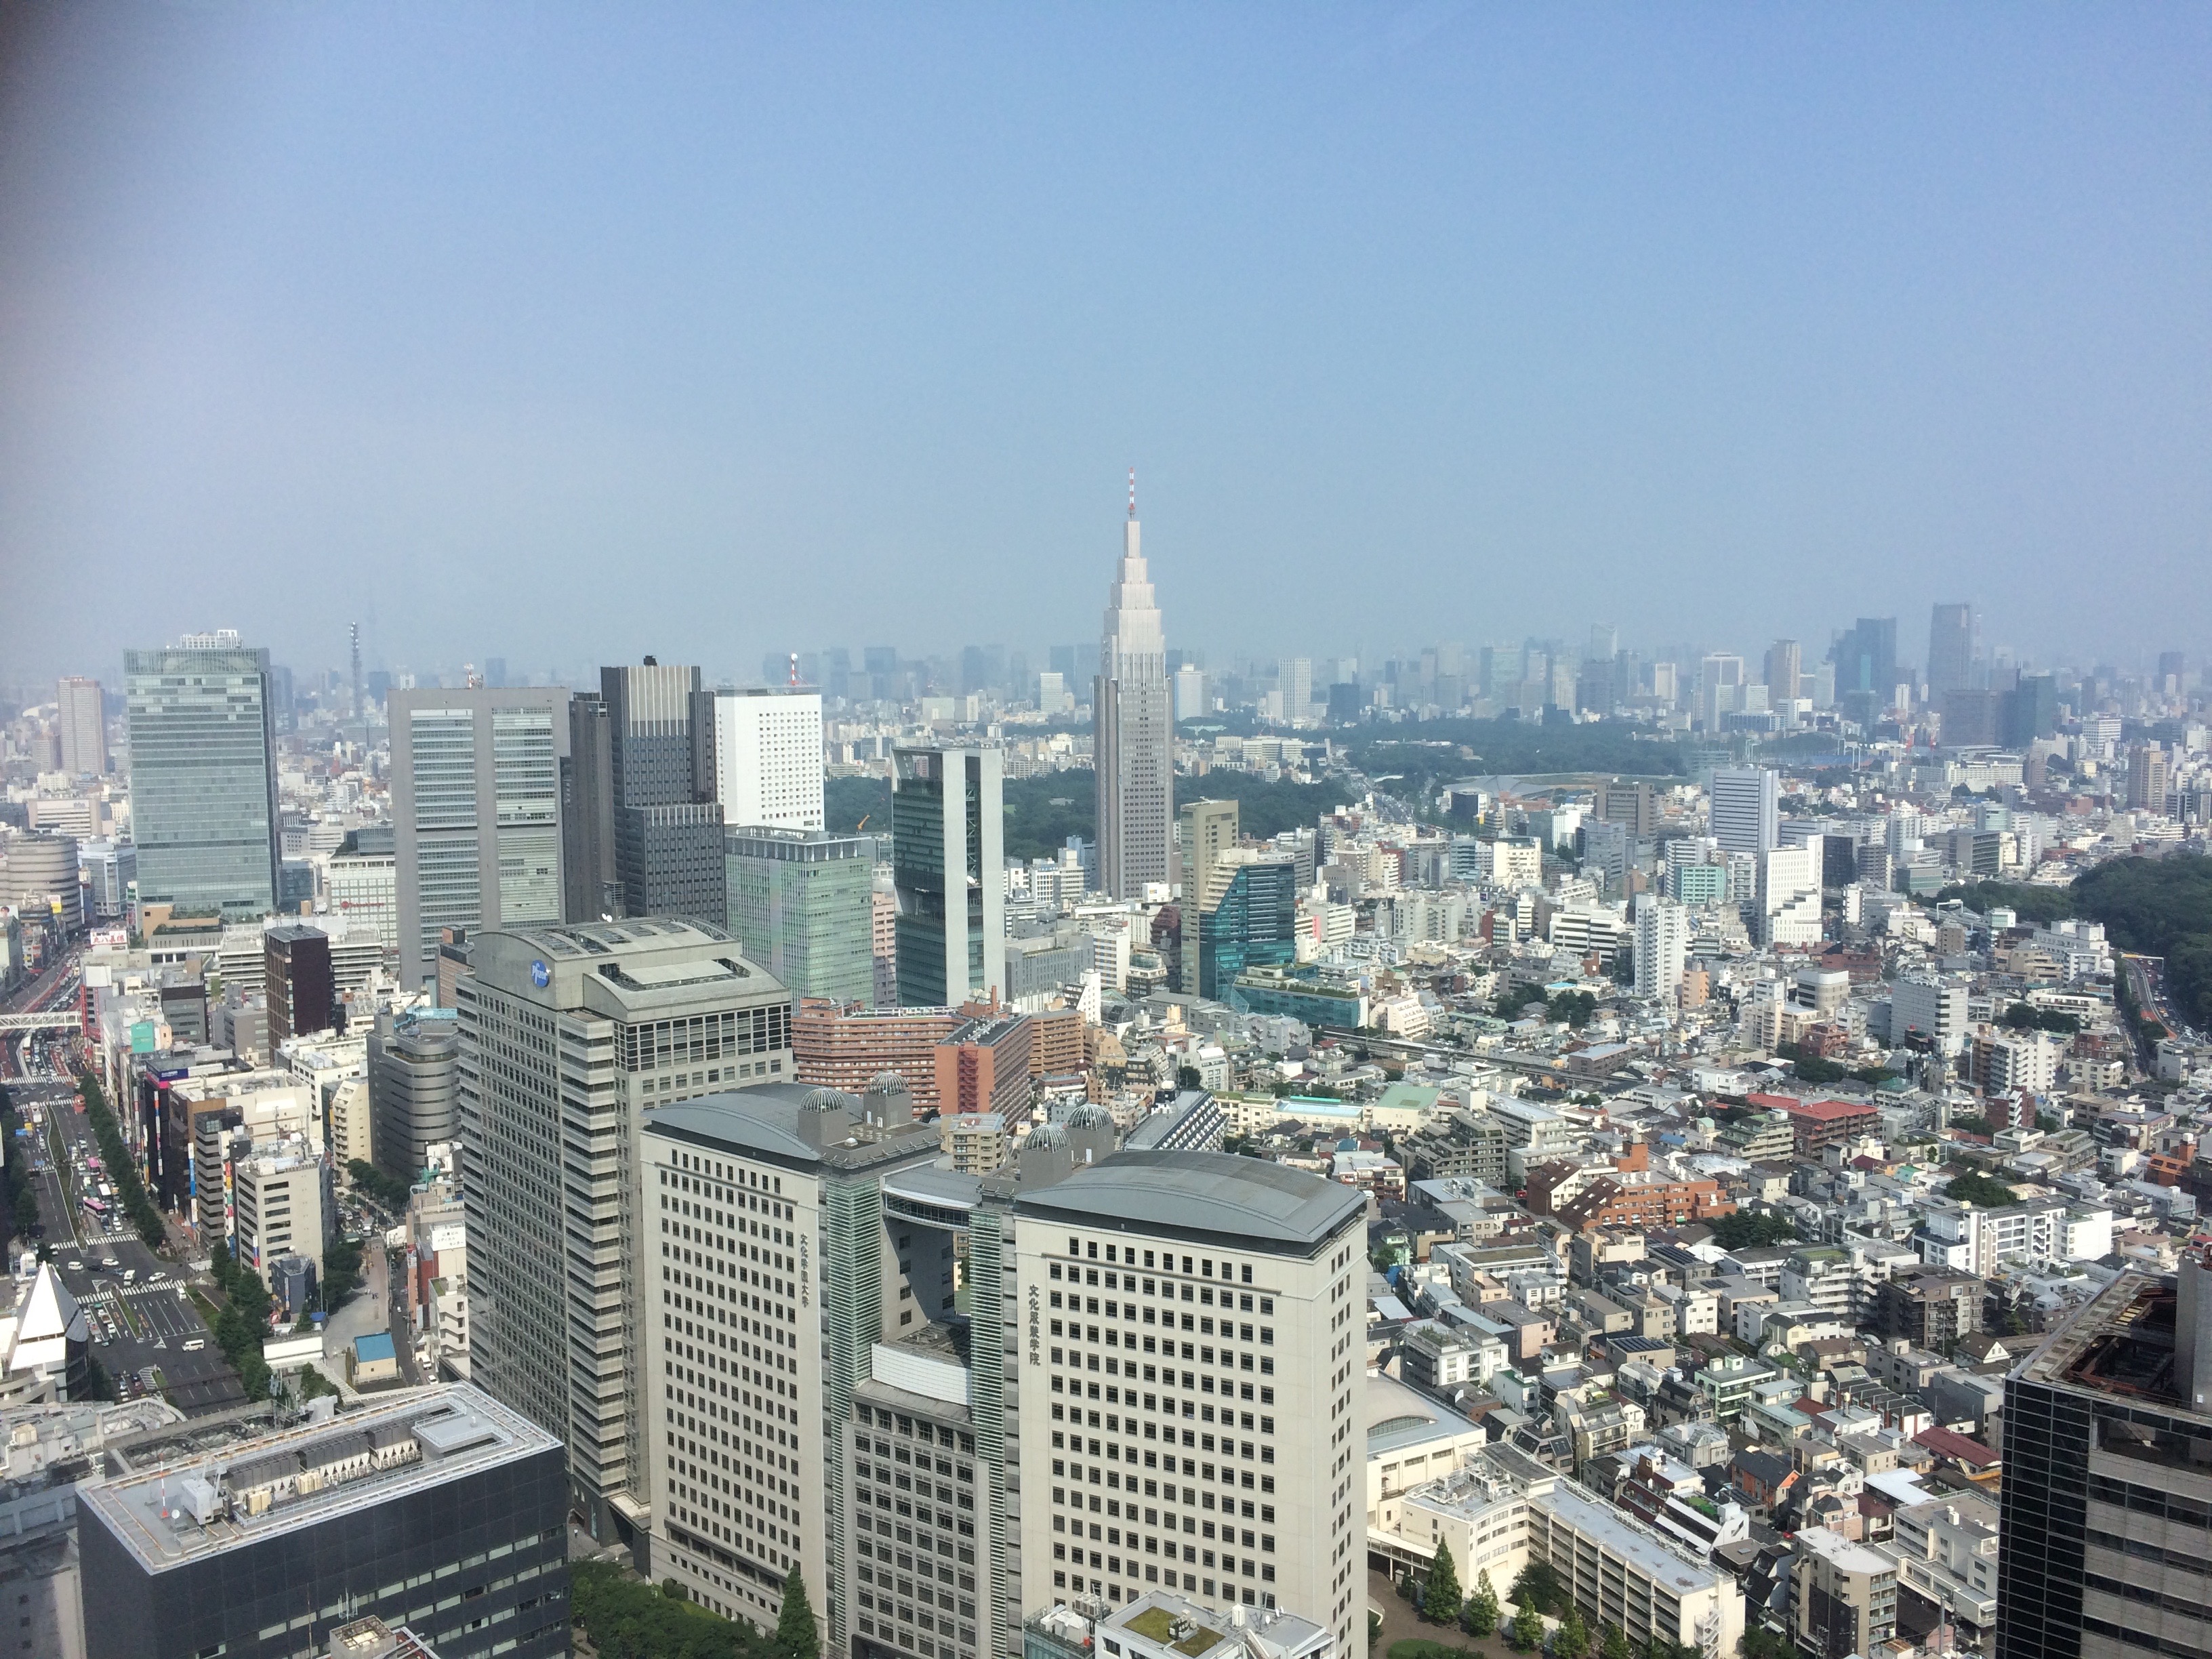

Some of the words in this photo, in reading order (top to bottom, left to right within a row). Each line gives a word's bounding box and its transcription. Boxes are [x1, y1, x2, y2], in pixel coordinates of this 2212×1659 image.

[531, 962, 548, 984] Pfizer
[1028, 1284, 1040, 1366] 文化服装学院
